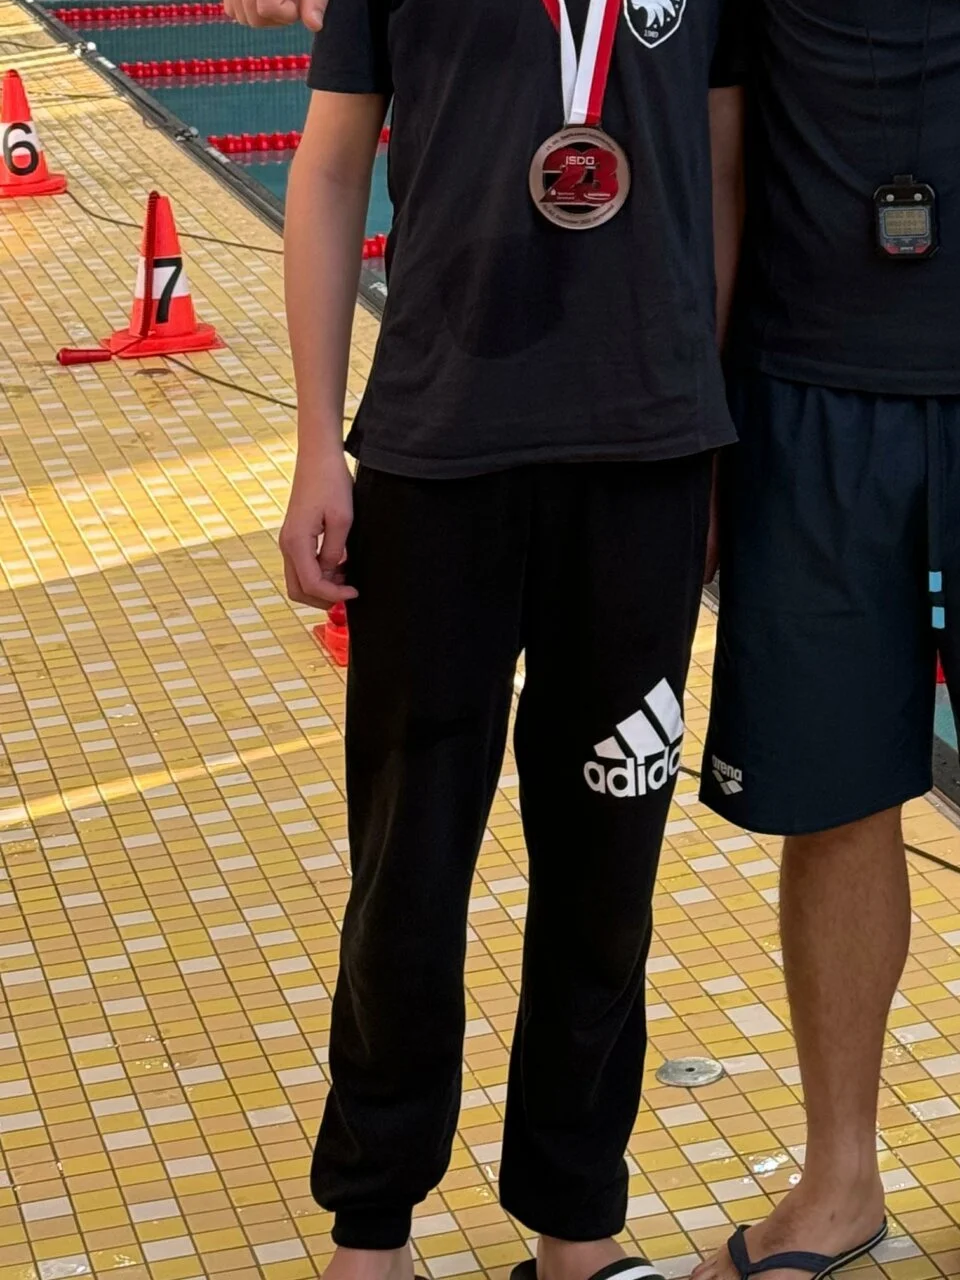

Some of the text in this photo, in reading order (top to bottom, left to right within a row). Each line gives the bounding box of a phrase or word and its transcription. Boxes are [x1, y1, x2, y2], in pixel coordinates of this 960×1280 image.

[2, 122, 40, 176] 6
[152, 256, 183, 324] 7
[583, 744, 684, 798] adida
[711, 754, 743, 783] arena
